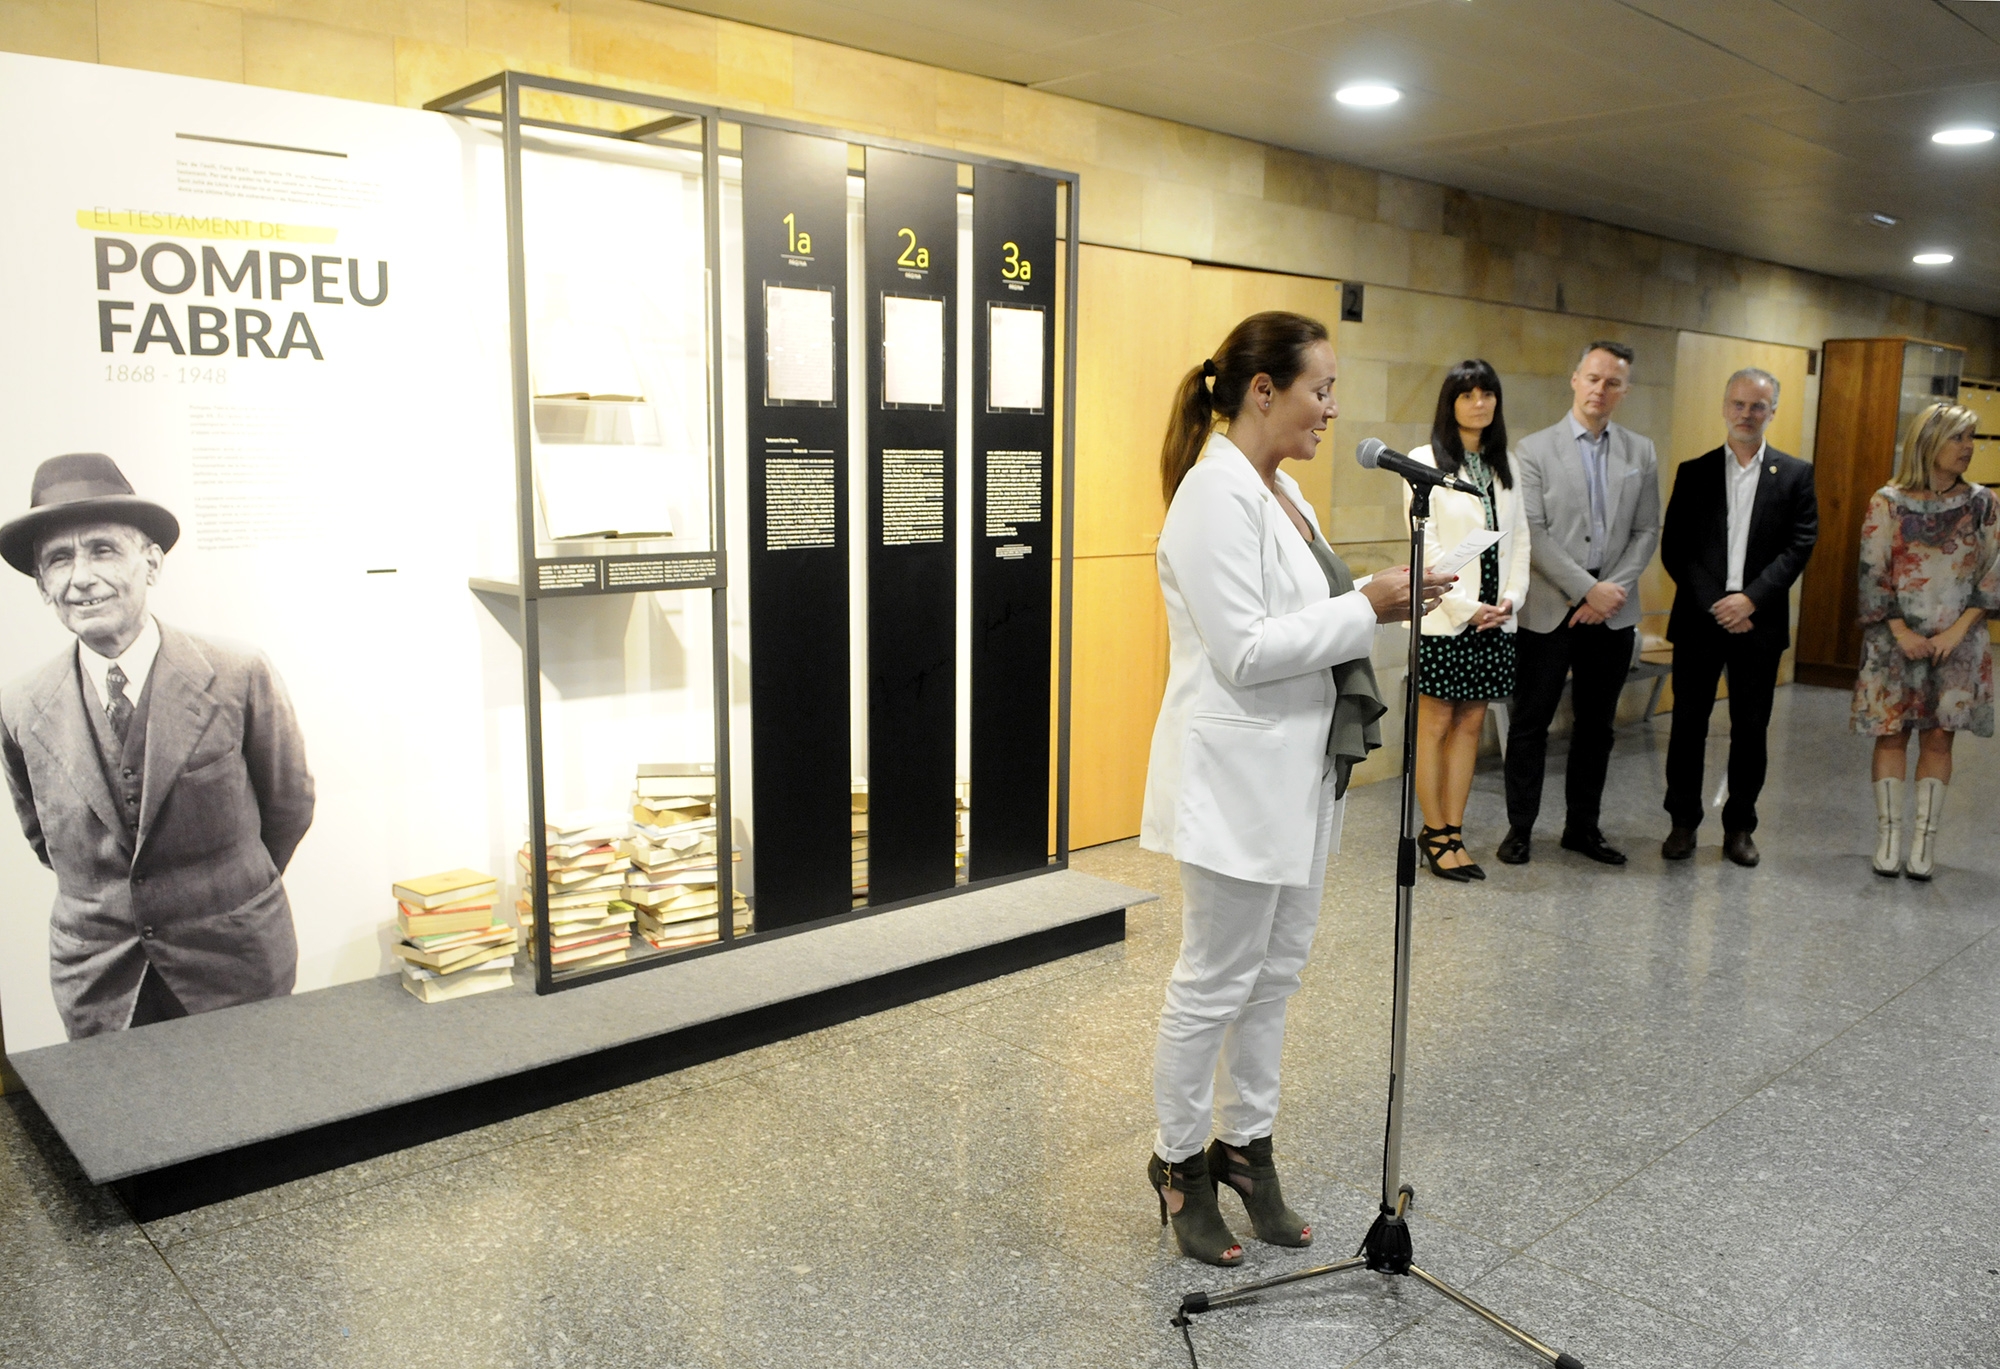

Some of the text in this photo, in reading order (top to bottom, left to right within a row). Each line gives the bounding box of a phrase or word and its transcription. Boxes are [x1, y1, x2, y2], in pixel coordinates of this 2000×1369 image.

[94, 206, 287, 240] EL TESTAMENT DE
[783, 212, 812, 255] 1a
[897, 227, 930, 269] 2a
[1001, 240, 1032, 281] 3a
[94, 237, 389, 307] POMPEU
[98, 300, 324, 361] FABRA
[105, 364, 155, 383] 1868
[178, 366, 226, 384] 1948
